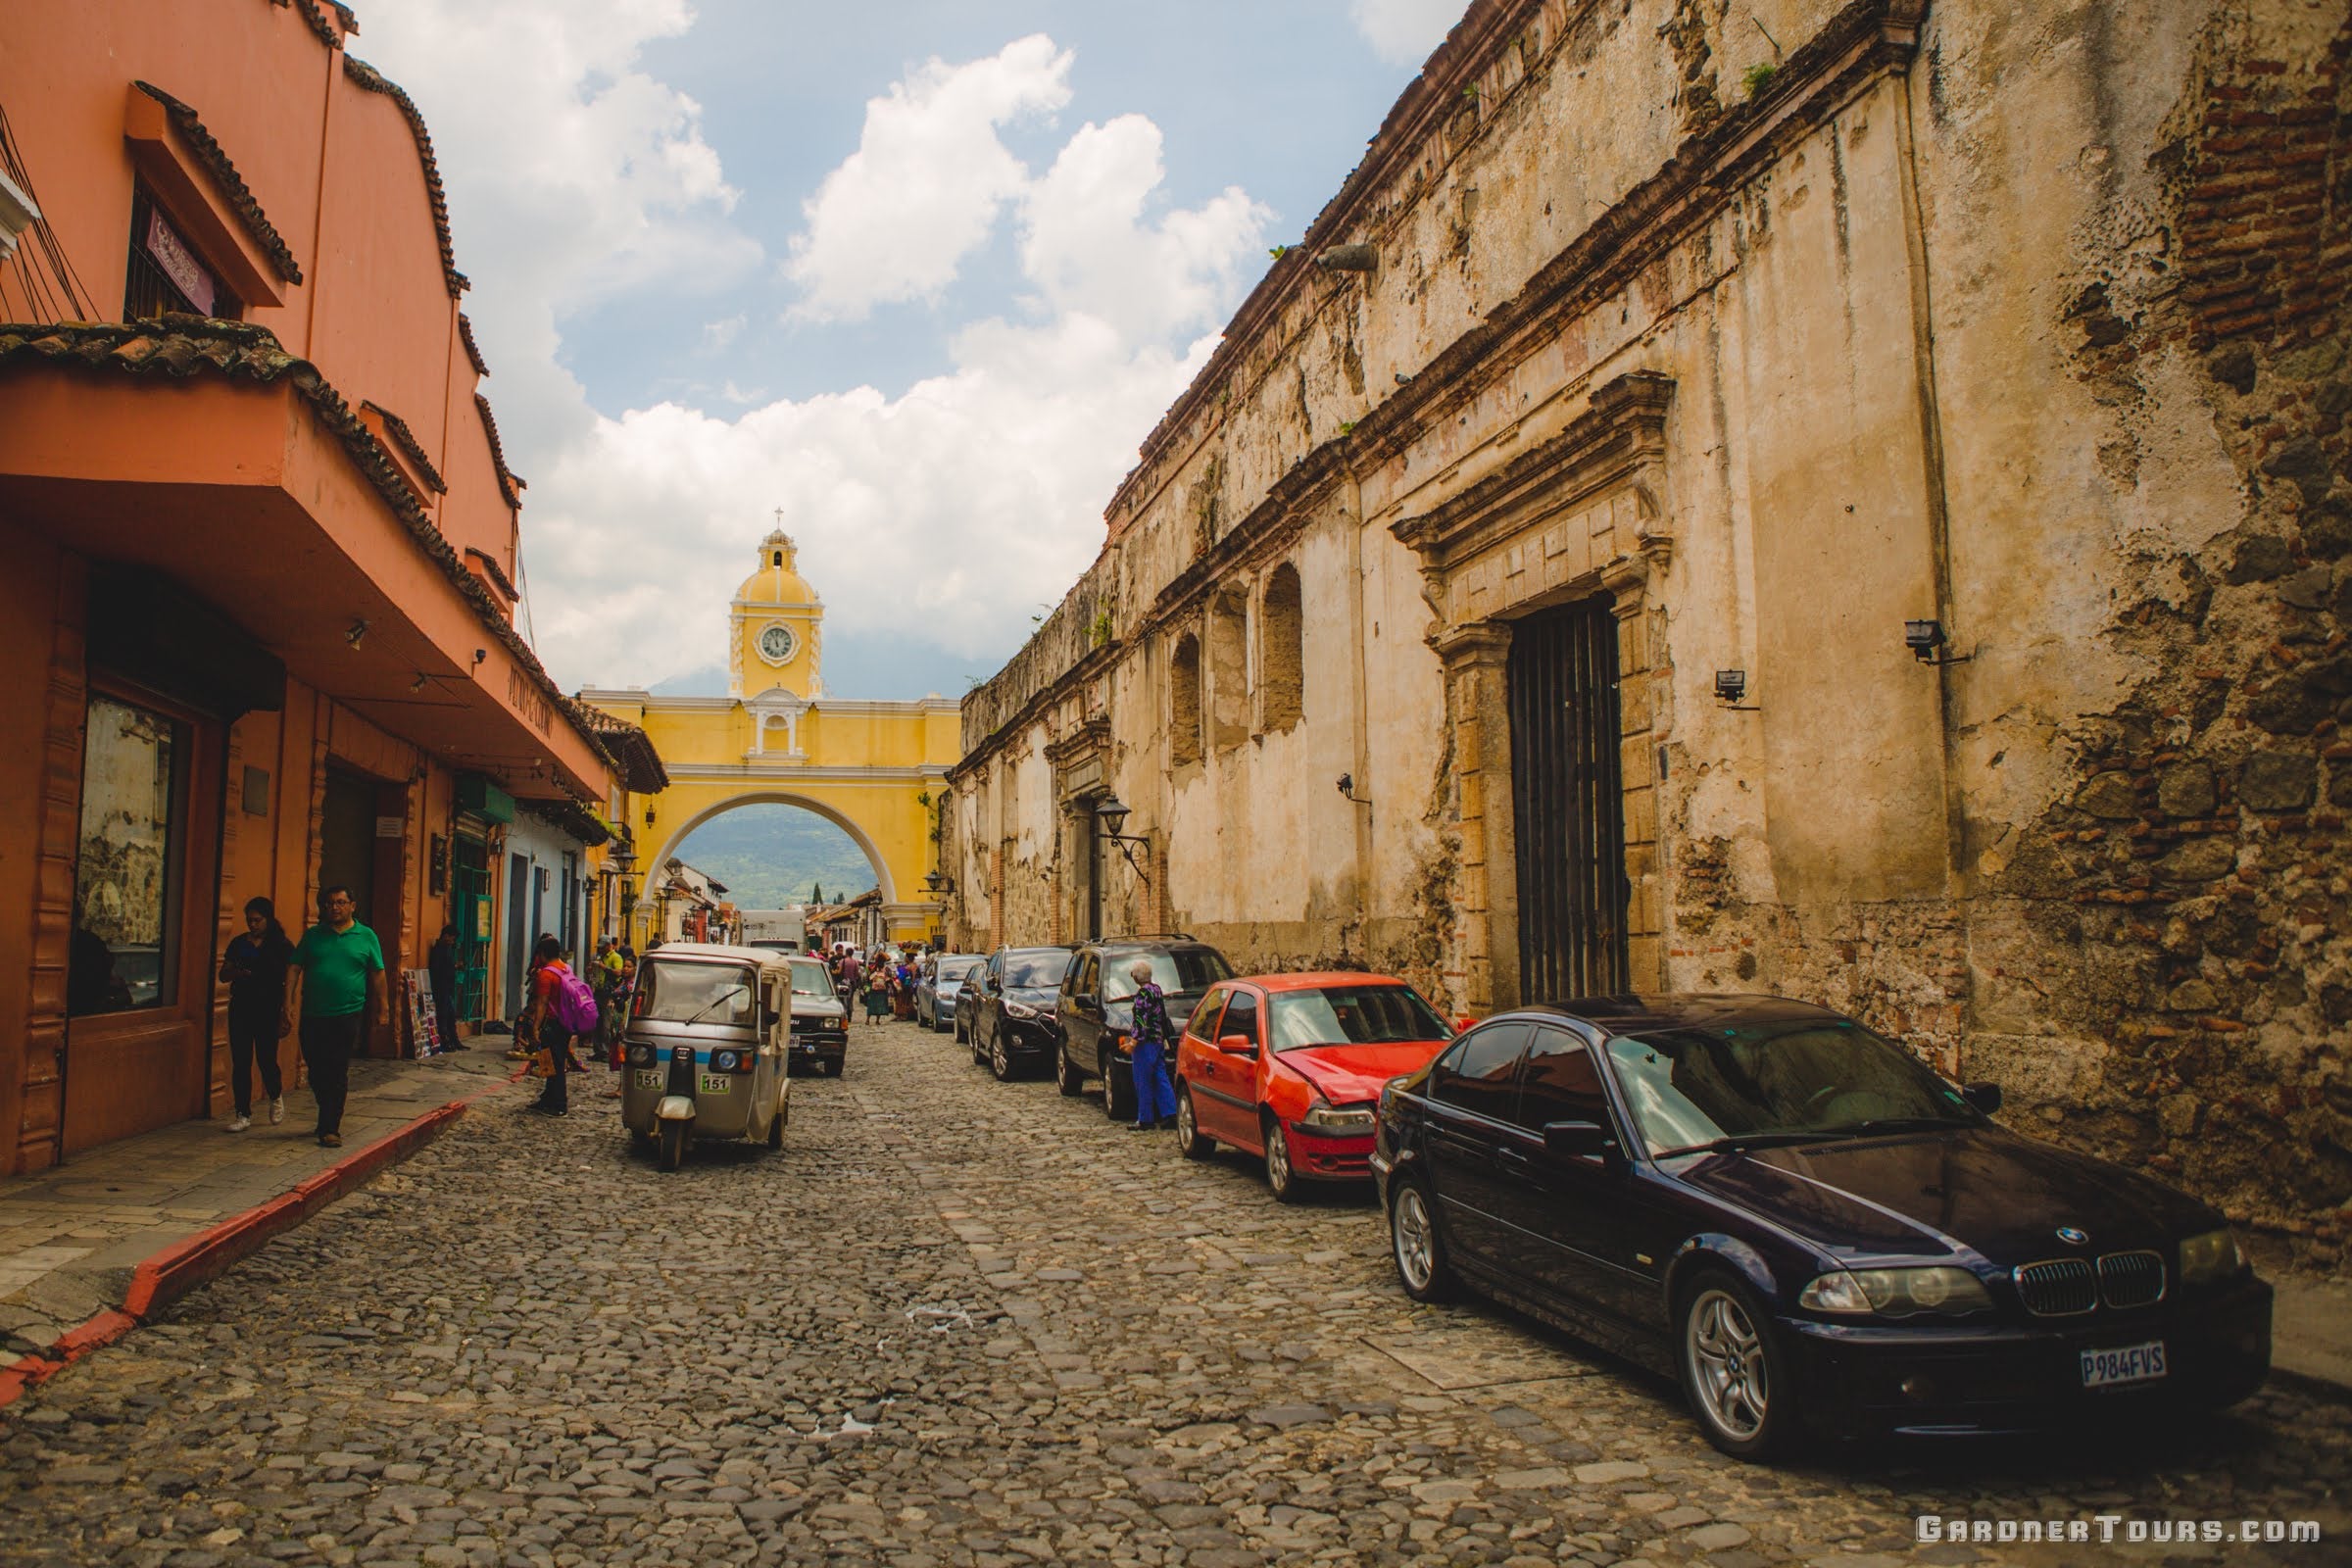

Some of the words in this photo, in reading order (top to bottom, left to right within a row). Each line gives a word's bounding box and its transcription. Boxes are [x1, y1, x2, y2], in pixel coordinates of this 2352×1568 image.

[639, 1074, 659, 1087] 151
[706, 1079, 726, 1090] 151
[2082, 1346, 2165, 1383] P984FVS
